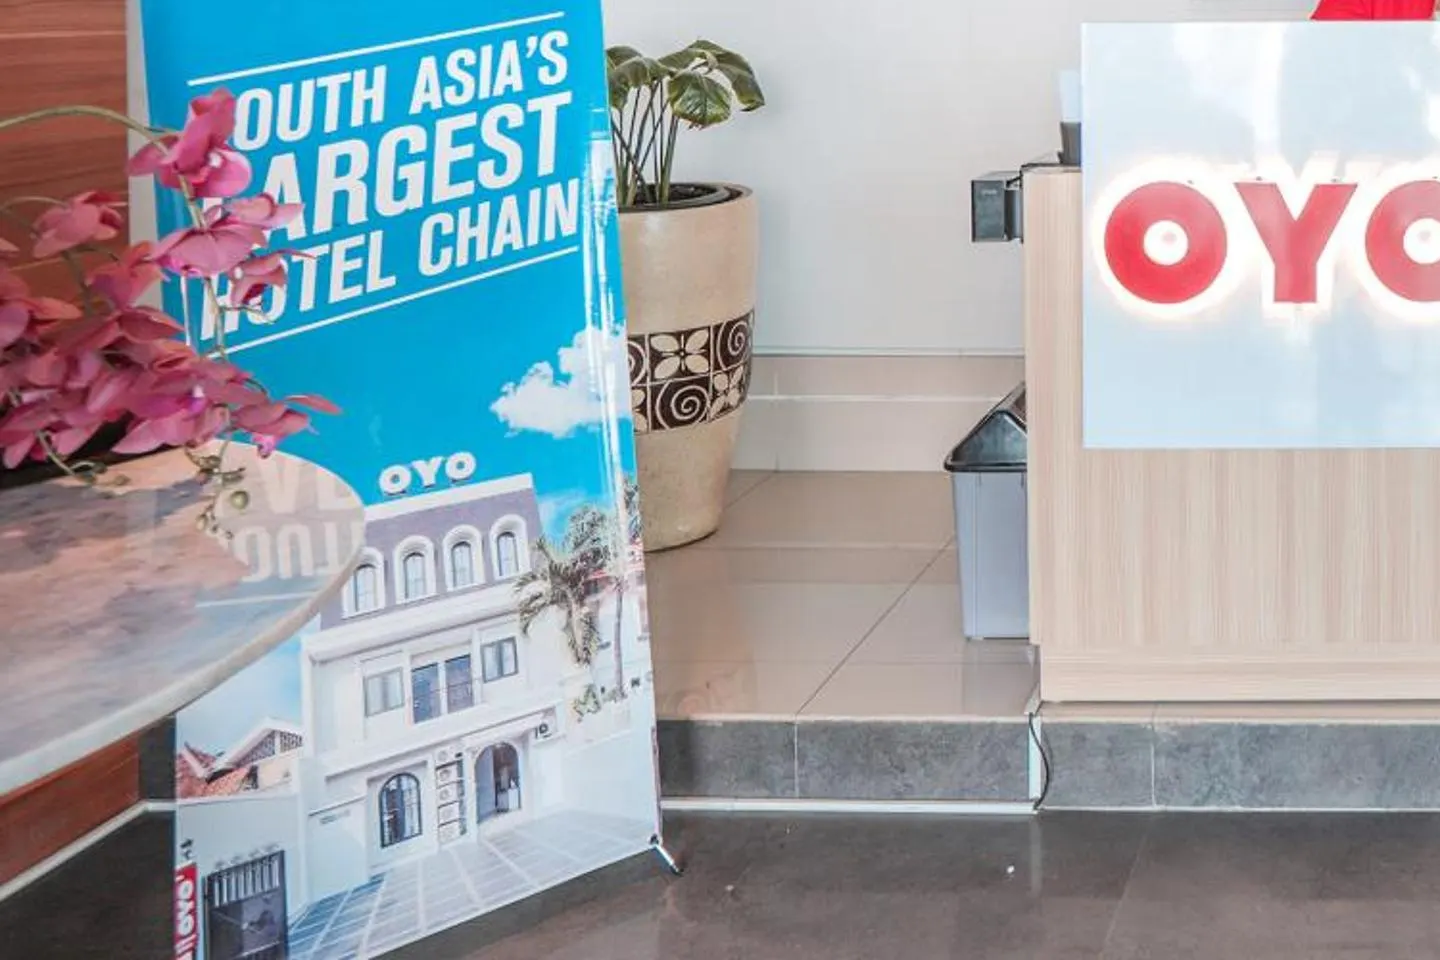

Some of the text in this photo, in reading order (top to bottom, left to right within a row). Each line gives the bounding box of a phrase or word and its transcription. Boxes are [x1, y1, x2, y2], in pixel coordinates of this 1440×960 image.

[213, 30, 570, 152] OUTH ASIA'S
[203, 92, 572, 250] ARGEST
[417, 178, 580, 277] CHAIN
[379, 451, 477, 494] OYO
